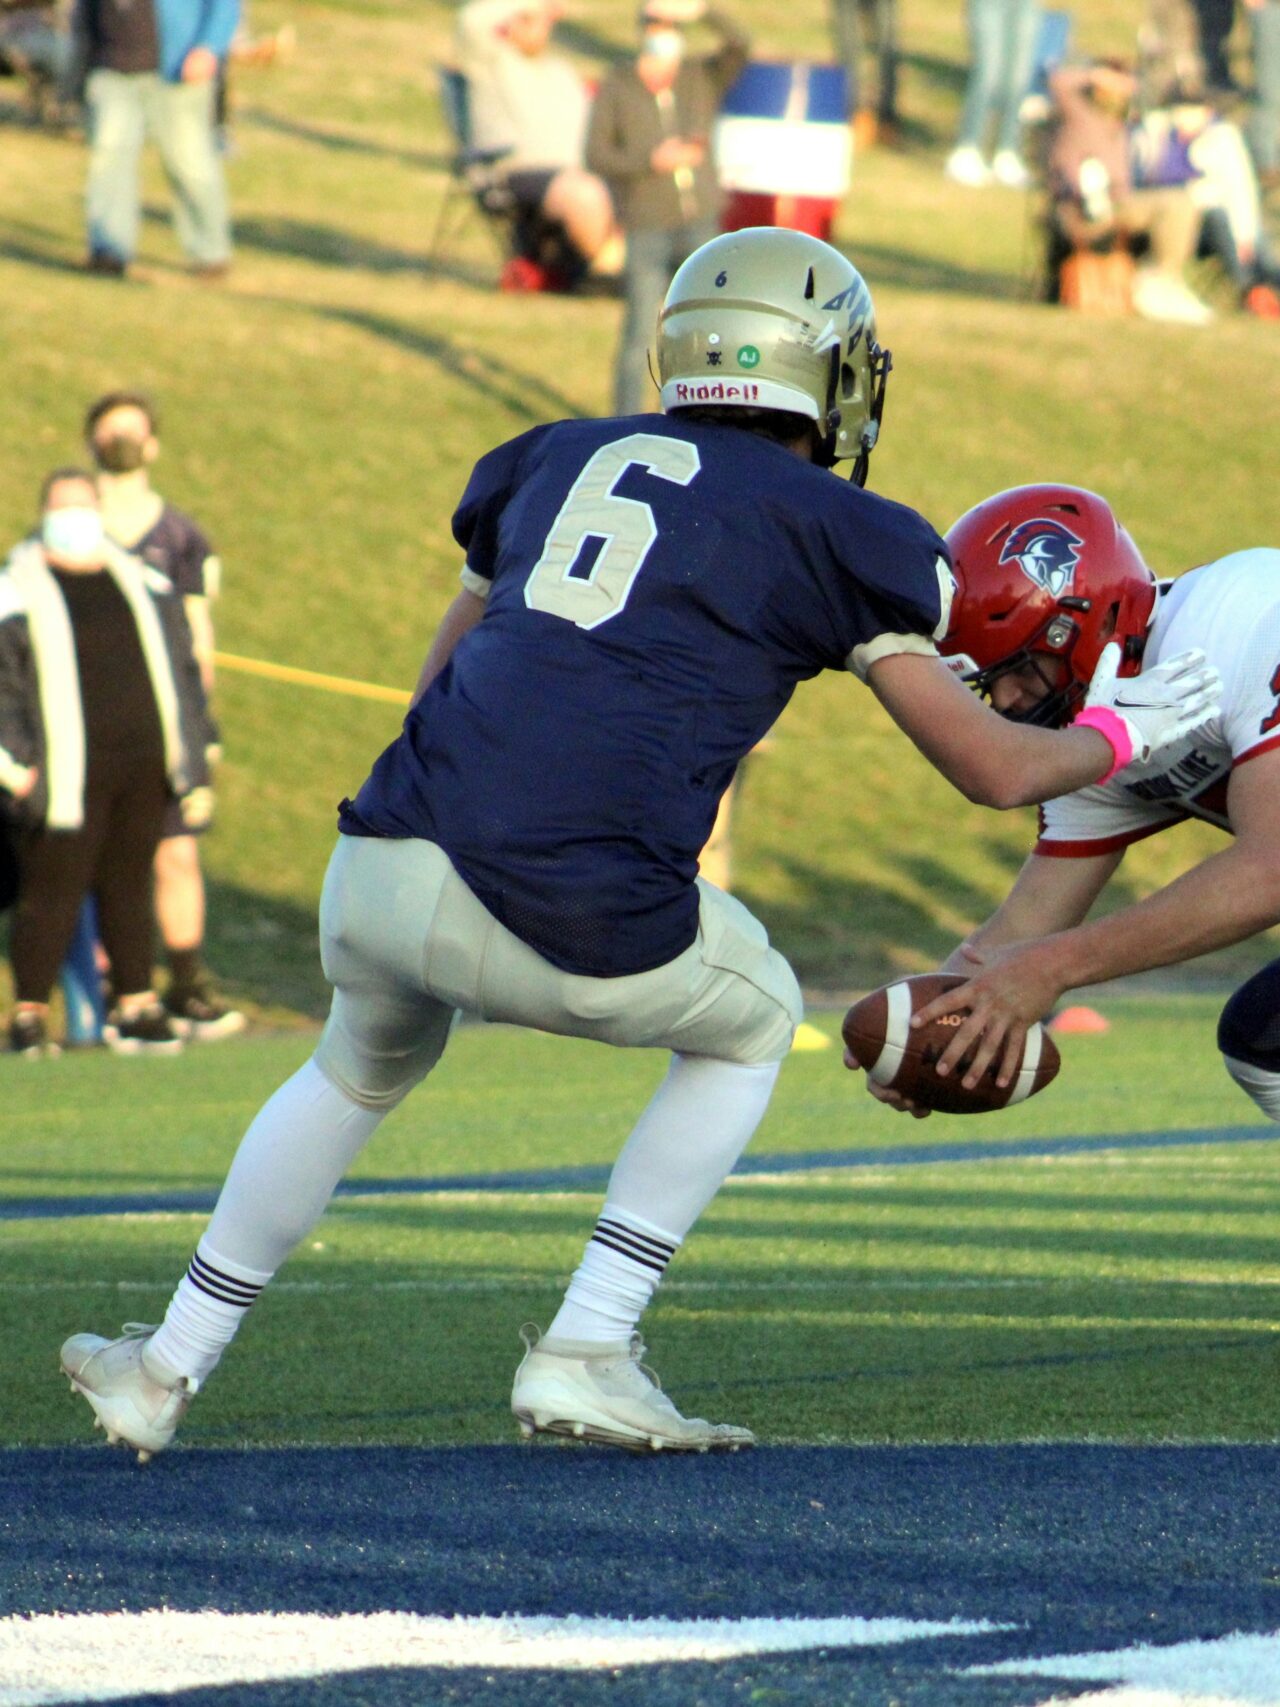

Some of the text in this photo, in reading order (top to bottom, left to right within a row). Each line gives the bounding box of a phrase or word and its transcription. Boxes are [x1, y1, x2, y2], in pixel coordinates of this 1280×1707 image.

[714, 270, 727, 288] 6
[740, 351, 757, 363] AJ
[676, 382, 758, 401] Riddell
[523, 432, 701, 631] 6
